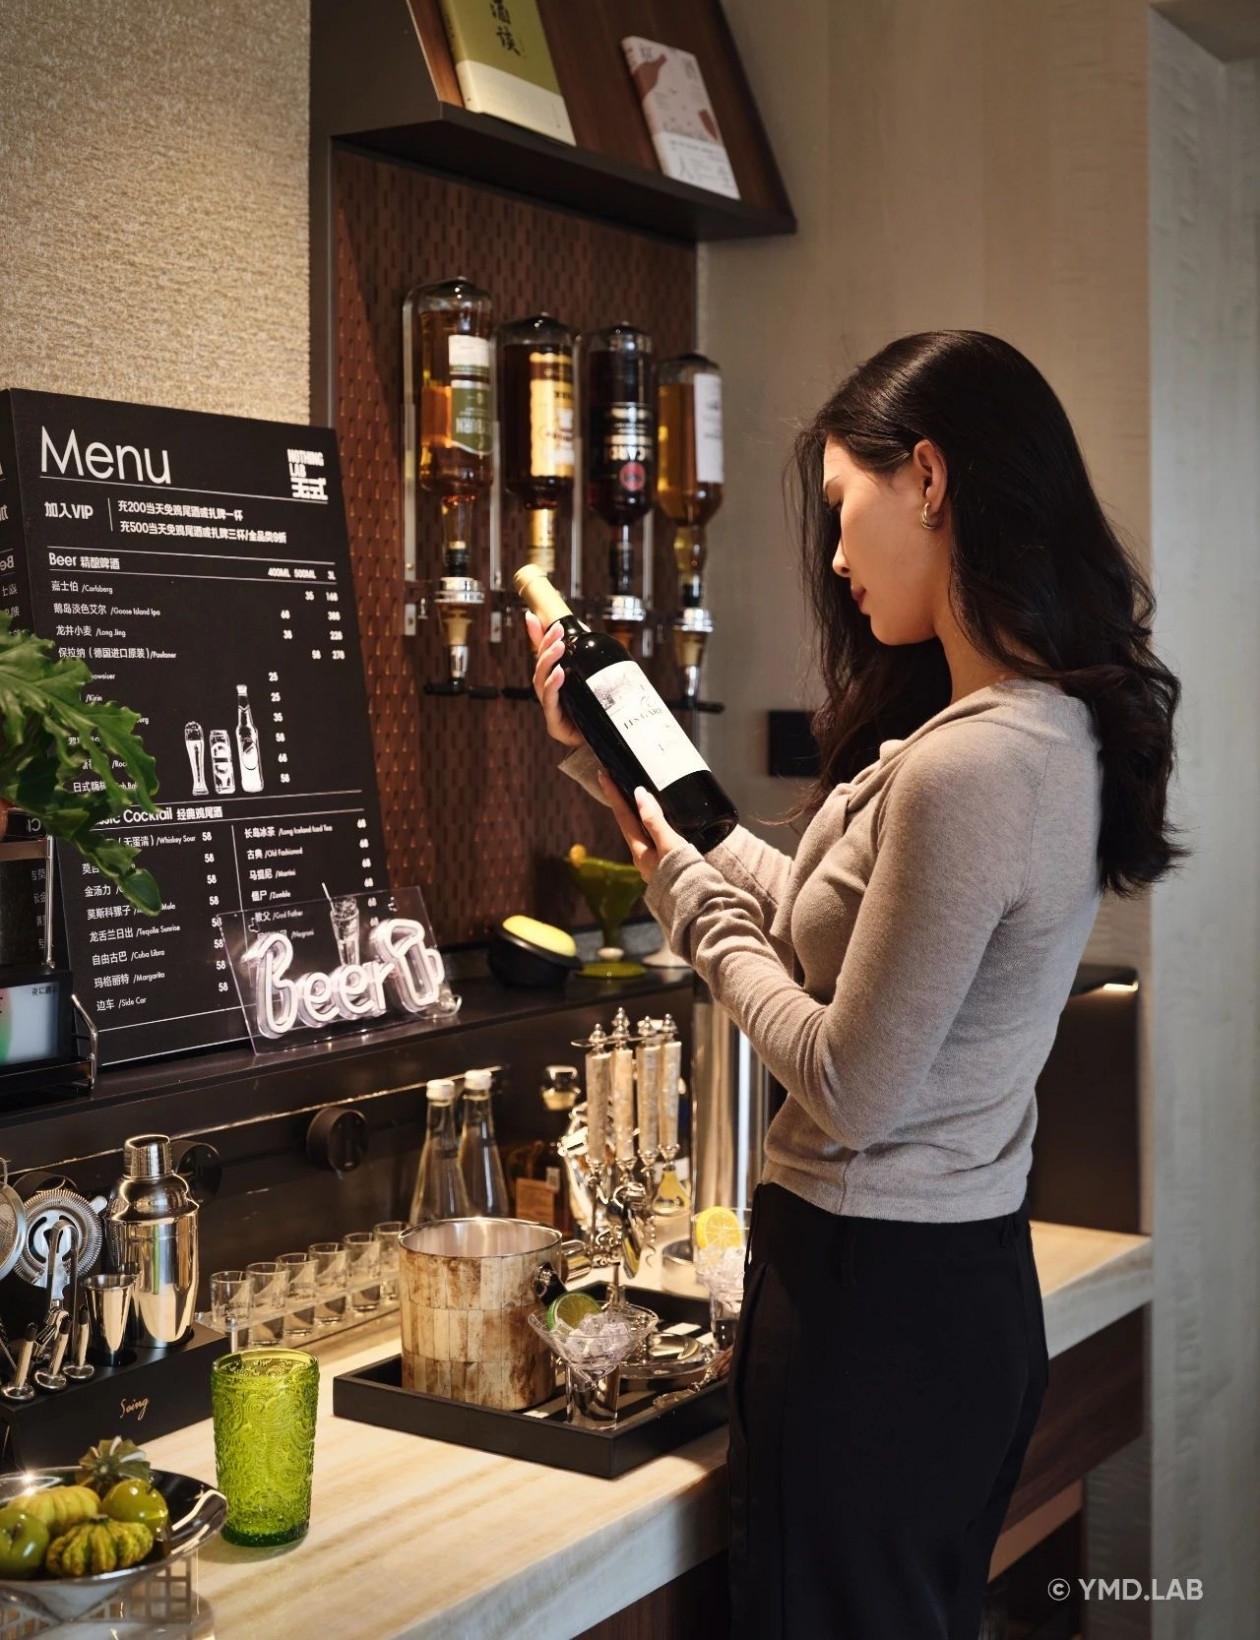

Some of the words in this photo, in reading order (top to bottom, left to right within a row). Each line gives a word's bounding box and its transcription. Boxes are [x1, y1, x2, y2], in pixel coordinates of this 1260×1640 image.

[41, 425, 171, 484] Menu
[44, 502, 94, 519] 加入VIP
[48, 552, 77, 567] Beer
[51, 580, 79, 592] 嘉士伯
[56, 625, 92, 636] 龙井小麦
[202, 831, 212, 841] 58
[204, 853, 214, 863] 58
[207, 874, 217, 884] 58
[84, 884, 111, 897] 金汤力
[209, 895, 219, 905] 58
[87, 905, 131, 920] 莫斯科骡子
[90, 927, 133, 943] 龙舌兰日出
[92, 951, 127, 966] 自由古巴
[216, 960, 226, 970] 58
[218, 982, 228, 992] 58
[97, 999, 114, 1012] 边车
